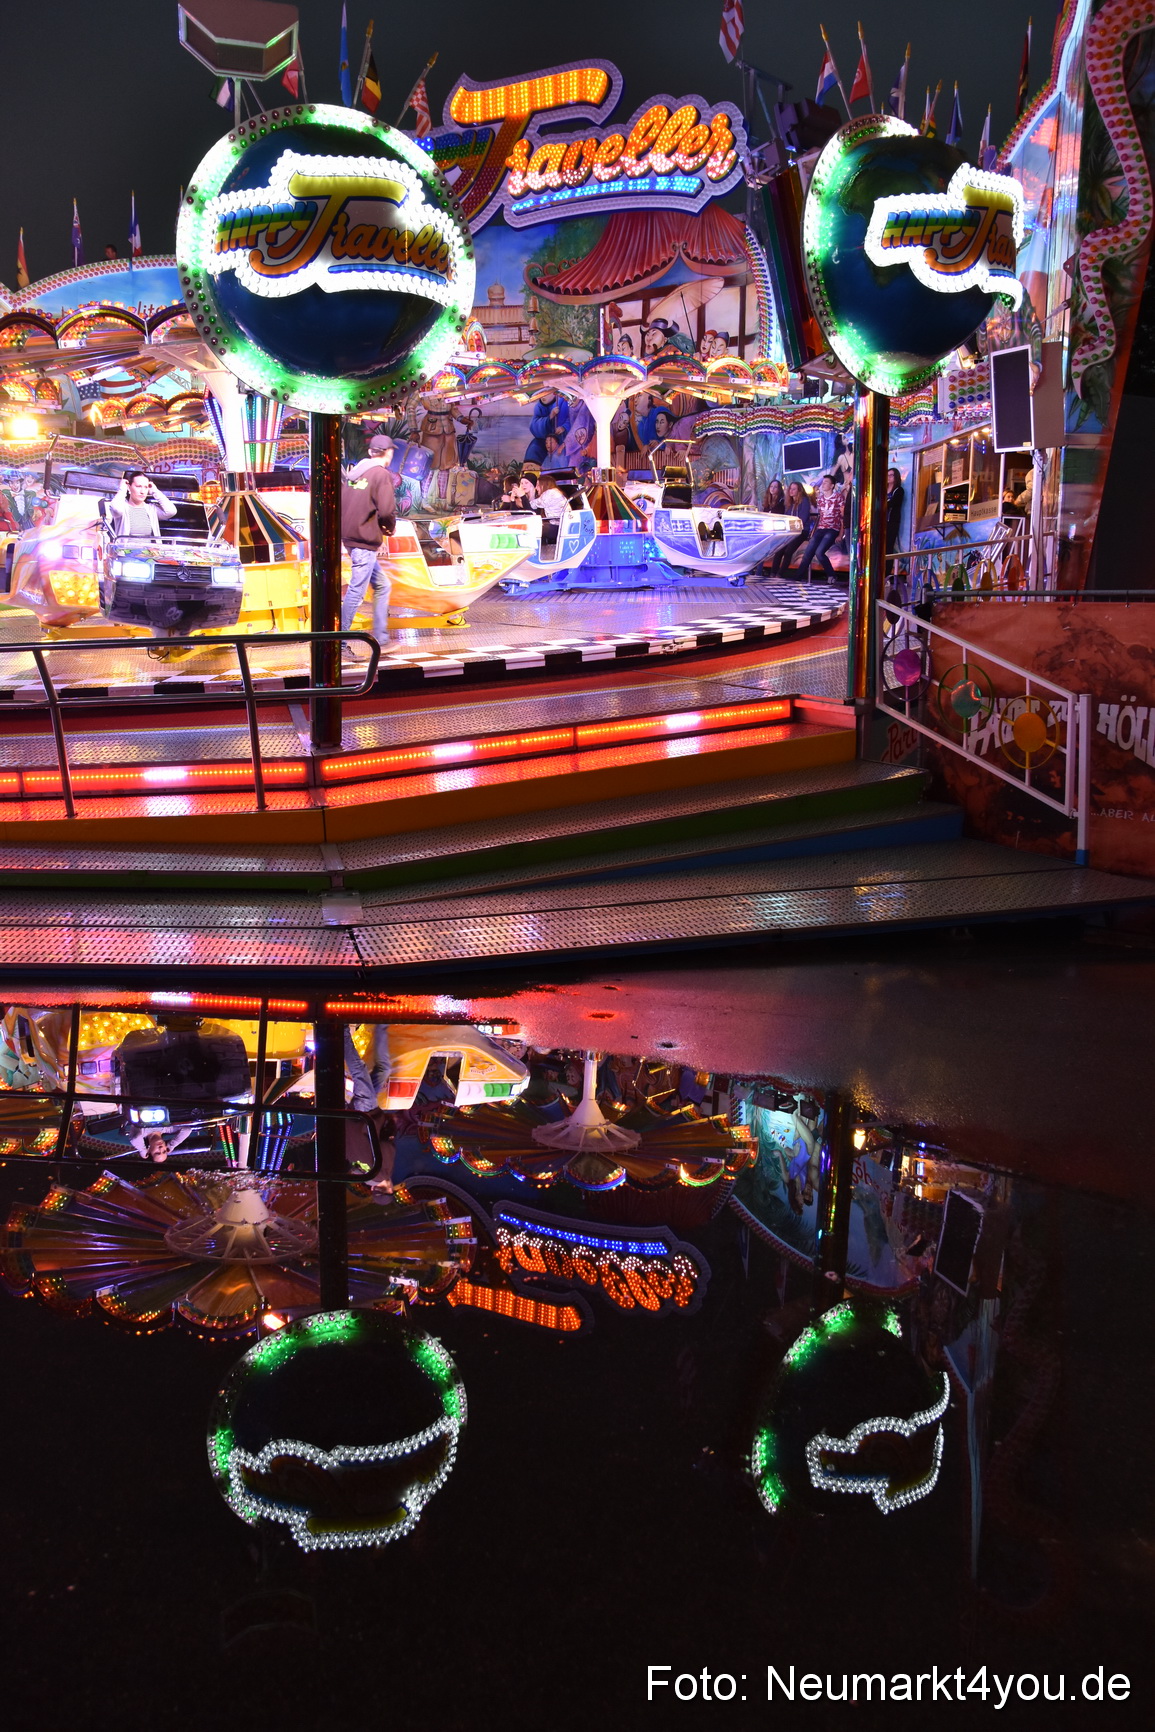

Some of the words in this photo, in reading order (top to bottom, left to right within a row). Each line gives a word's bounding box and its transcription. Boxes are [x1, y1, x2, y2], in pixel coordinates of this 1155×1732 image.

[450, 67, 736, 218] Traveller
[215, 201, 317, 258] HAPPY
[881, 209, 980, 258] HAPPY
